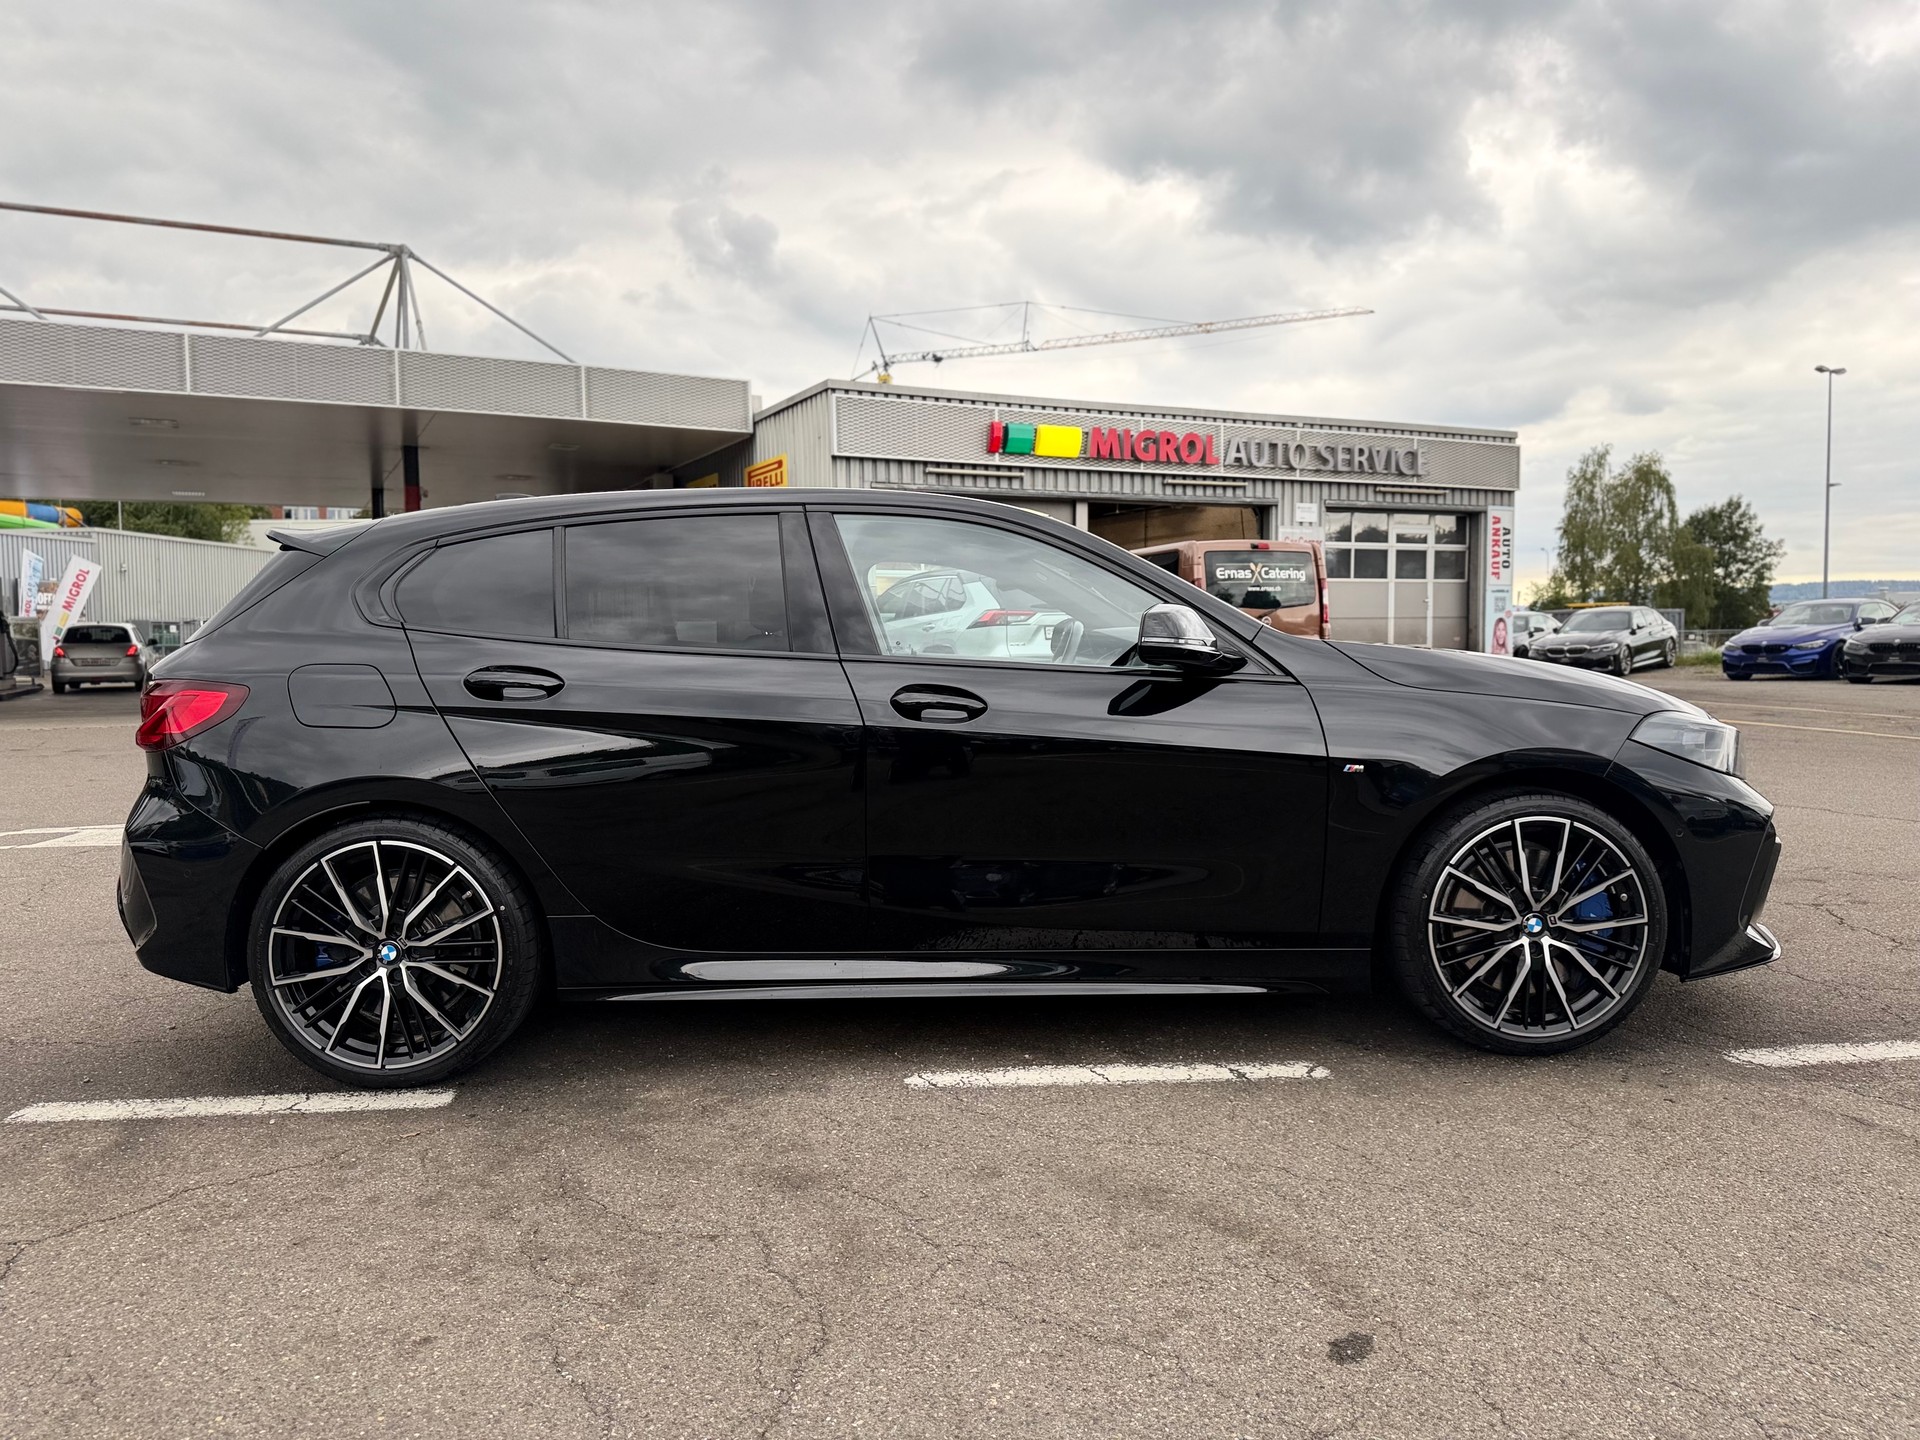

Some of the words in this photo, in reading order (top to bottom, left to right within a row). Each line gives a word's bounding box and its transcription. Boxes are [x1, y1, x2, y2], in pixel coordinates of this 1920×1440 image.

[1089, 427, 1219, 464] MIGROL
[1224, 437, 1310, 469] AUTO
[1319, 441, 1428, 475] SERVICE
[1490, 515, 1501, 580] ANKAUF
[1501, 527, 1511, 569] AUTO
[62, 568, 90, 612] MIGROL
[1216, 567, 1252, 579] Ernas
[1261, 567, 1306, 581] Catering
